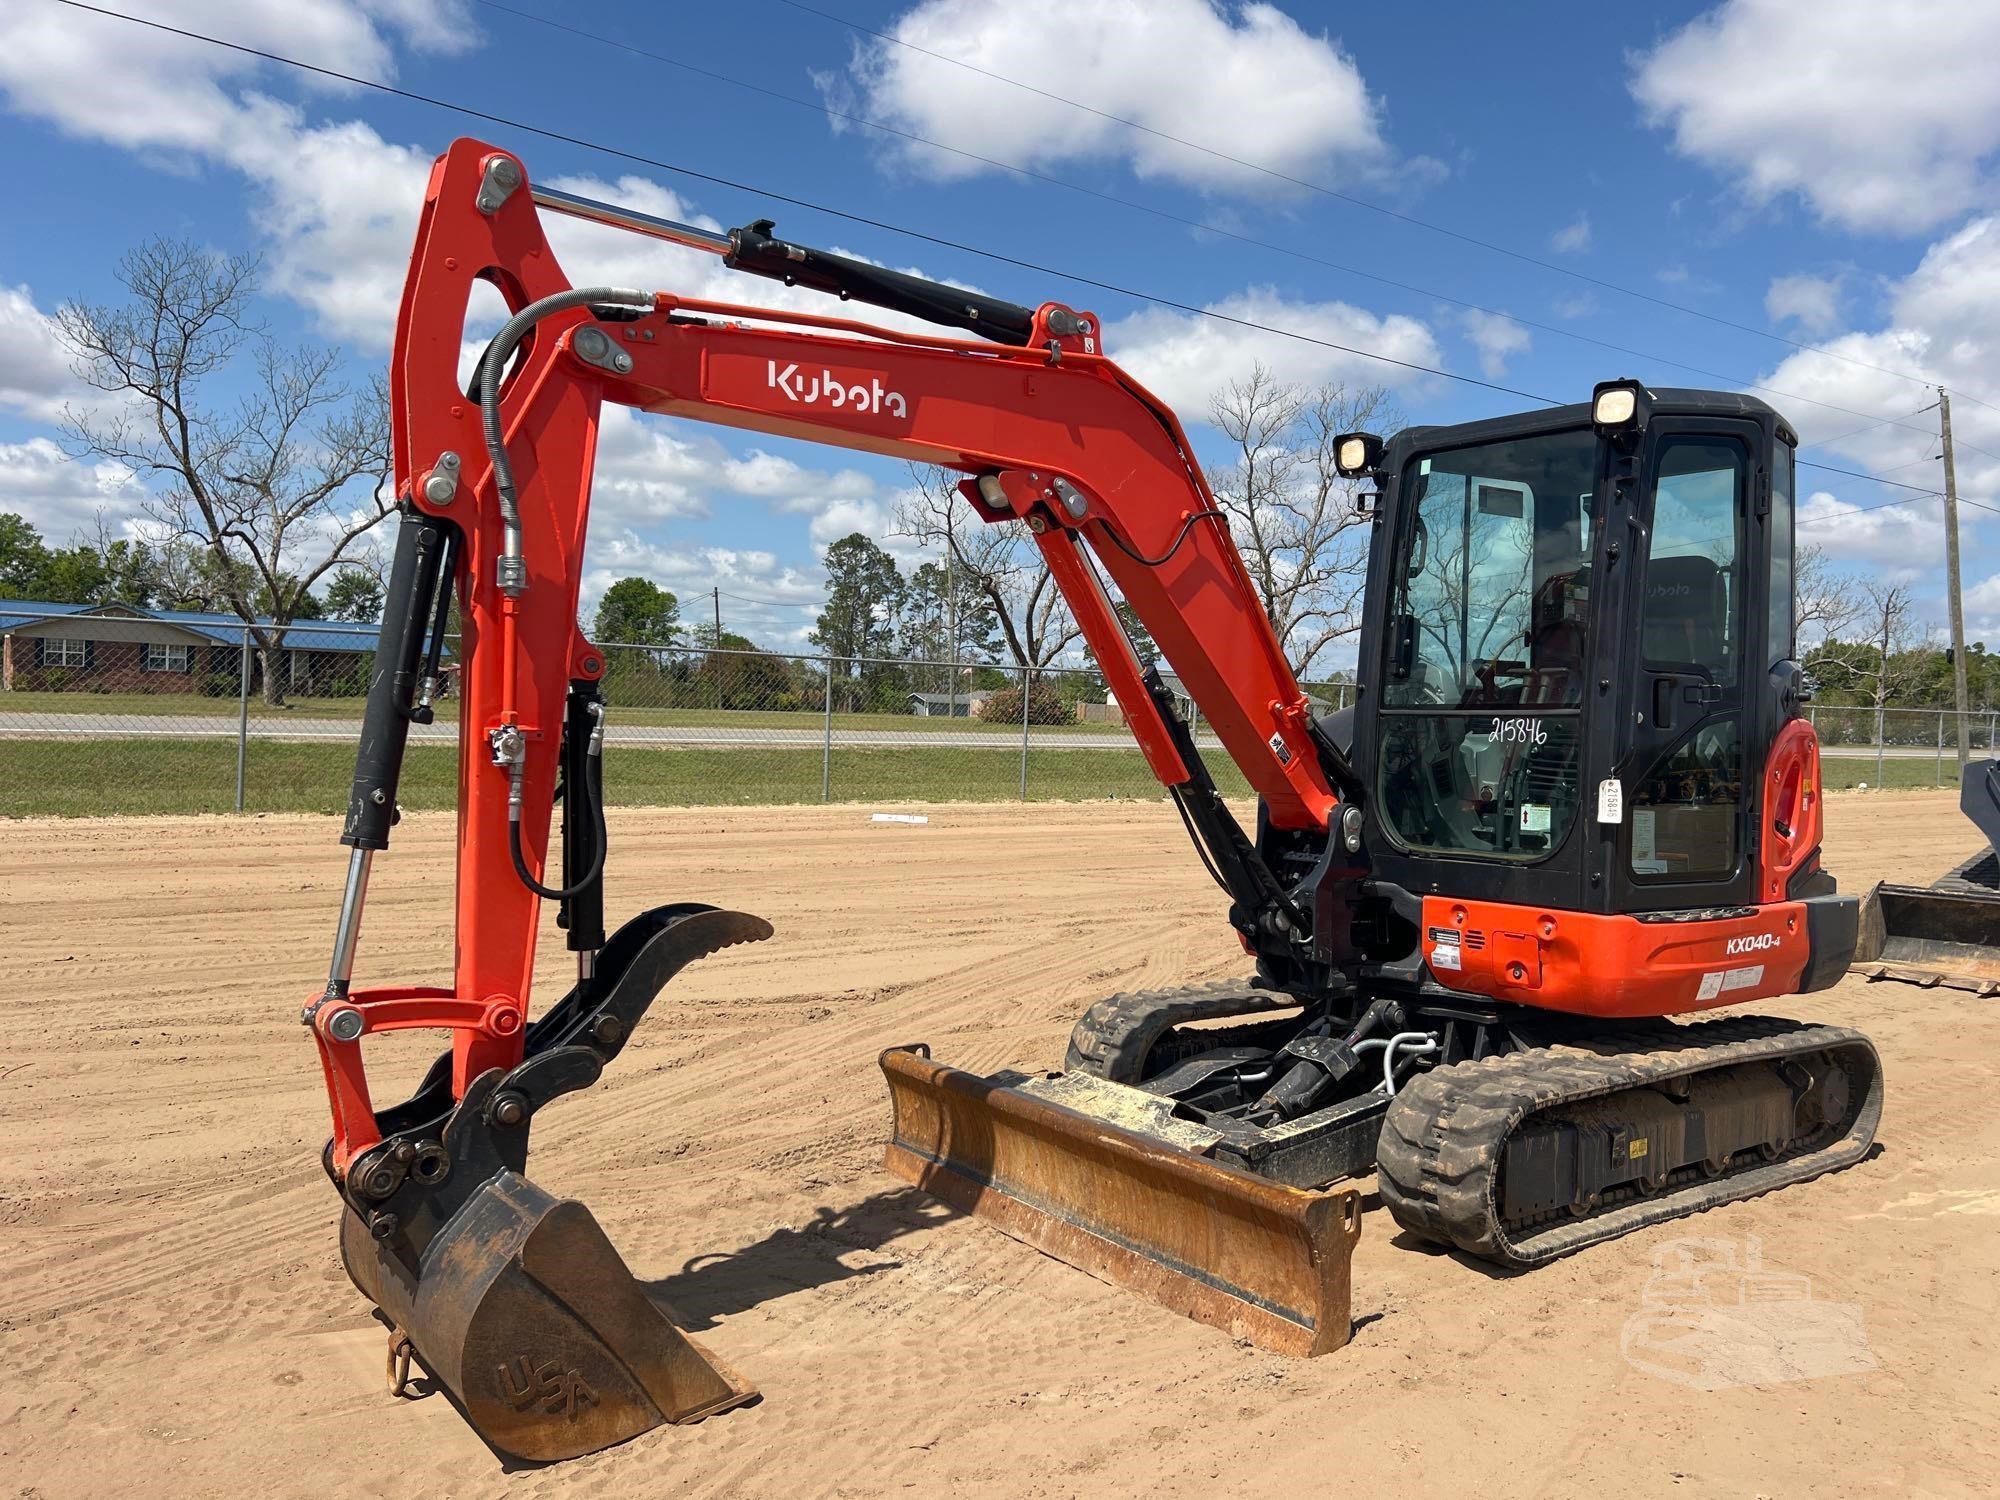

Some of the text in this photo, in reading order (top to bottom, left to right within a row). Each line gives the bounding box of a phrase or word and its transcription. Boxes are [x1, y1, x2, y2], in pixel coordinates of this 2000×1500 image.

[768, 360, 907, 418] Kubota
[1647, 583, 1690, 598] ubota
[1488, 717, 1547, 745] 215846
[1726, 933, 1780, 955] KX040-4
[497, 1354, 600, 1423] USA
